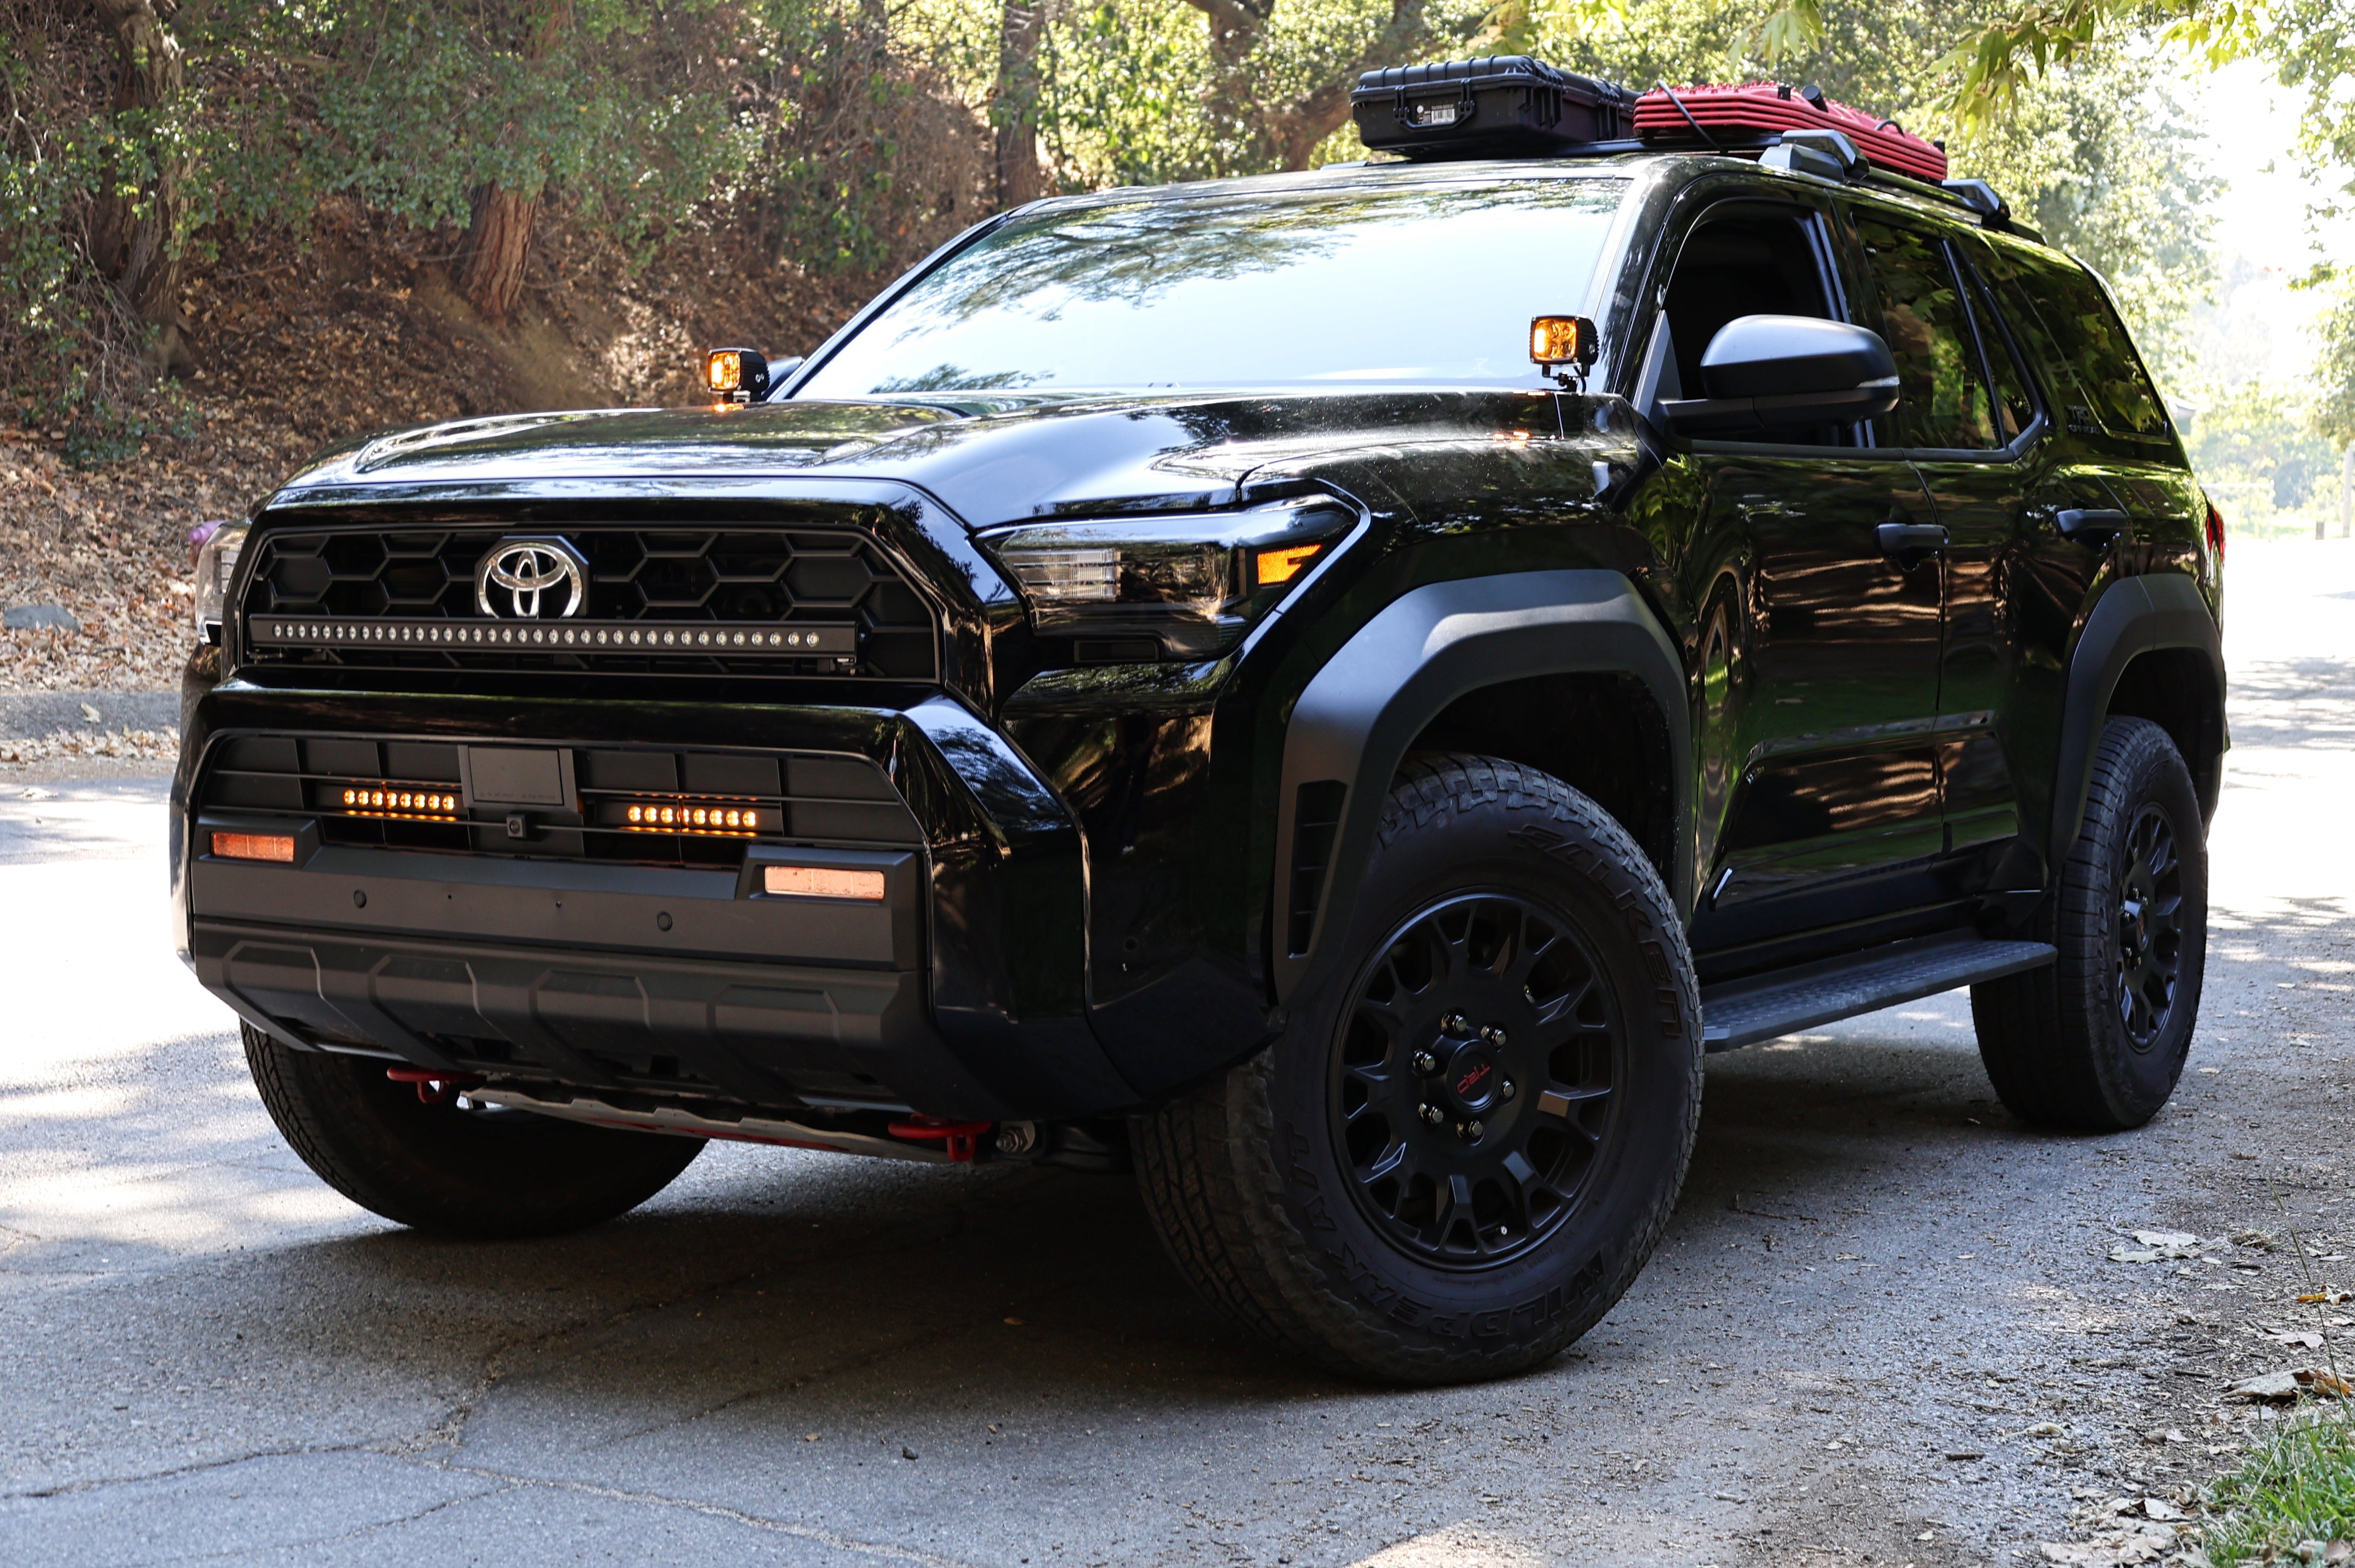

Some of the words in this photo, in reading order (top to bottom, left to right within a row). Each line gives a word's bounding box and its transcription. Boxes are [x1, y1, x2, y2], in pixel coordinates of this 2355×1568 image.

[1508, 824, 1682, 1037] FALKEN
[1456, 1063, 1491, 1094] TRD
[1327, 1248, 1607, 1338] WILDPEAK
